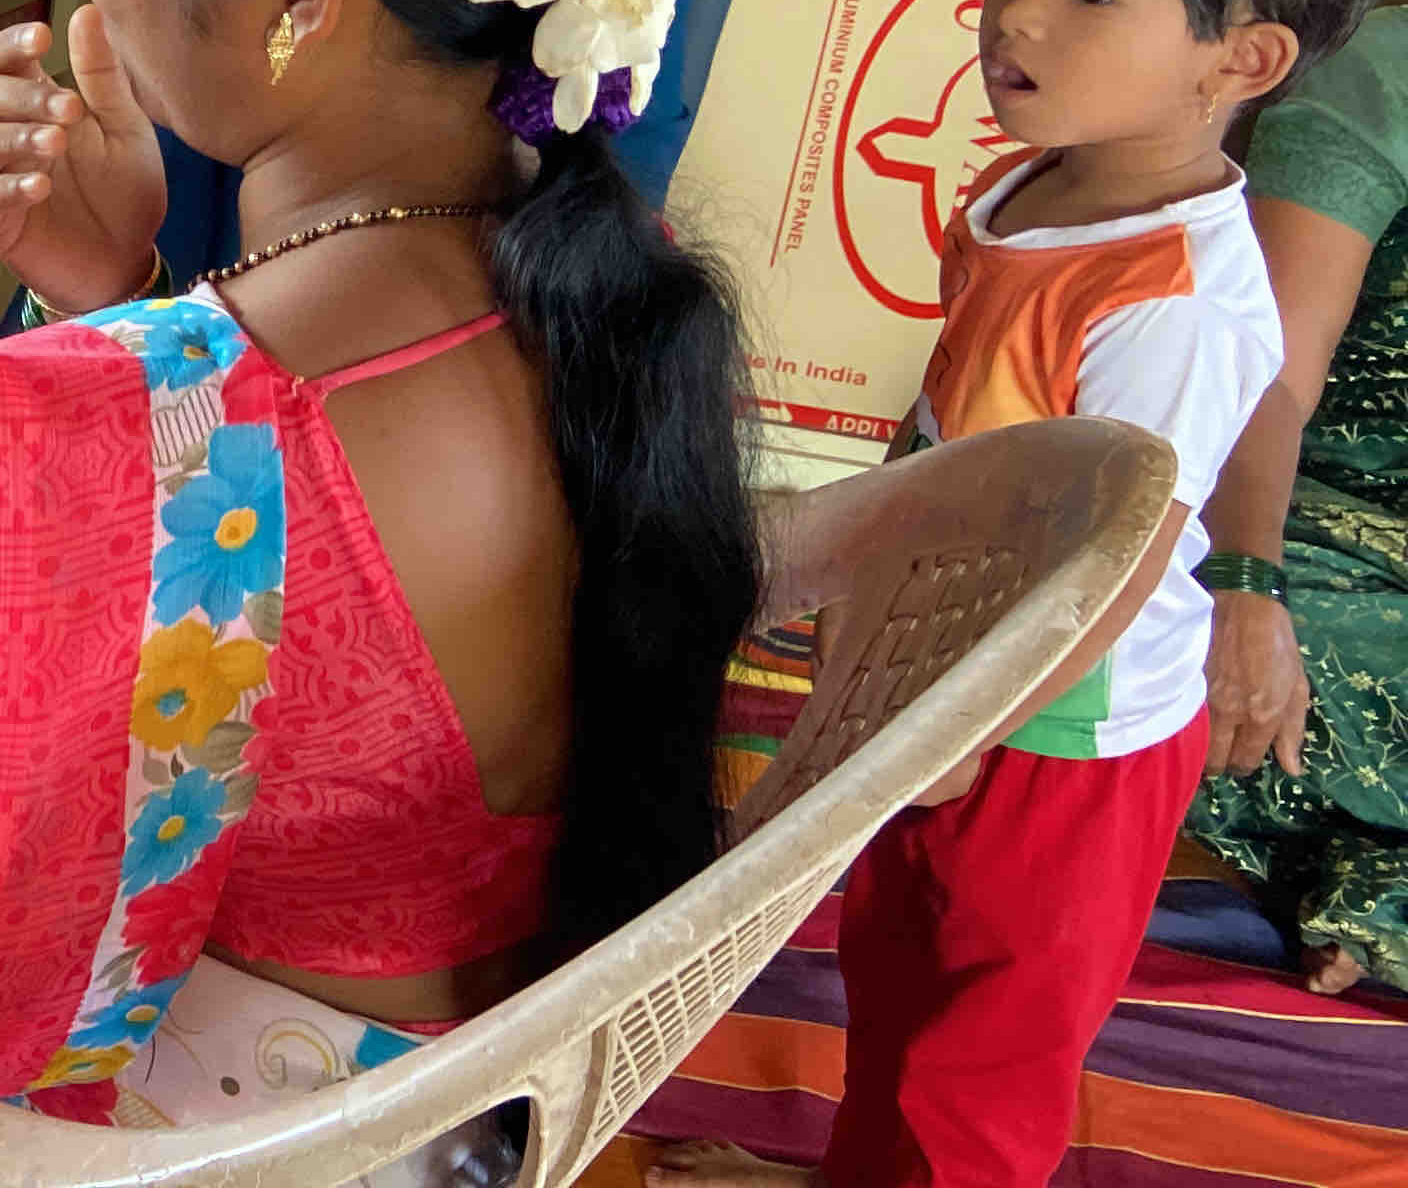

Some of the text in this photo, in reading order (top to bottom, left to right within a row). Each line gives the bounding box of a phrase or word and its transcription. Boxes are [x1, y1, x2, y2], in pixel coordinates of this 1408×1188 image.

[800, 78, 840, 196] COMPOSITES
[784, 198, 812, 253] PANEL
[775, 357, 797, 374] In
[806, 361, 867, 386] India
